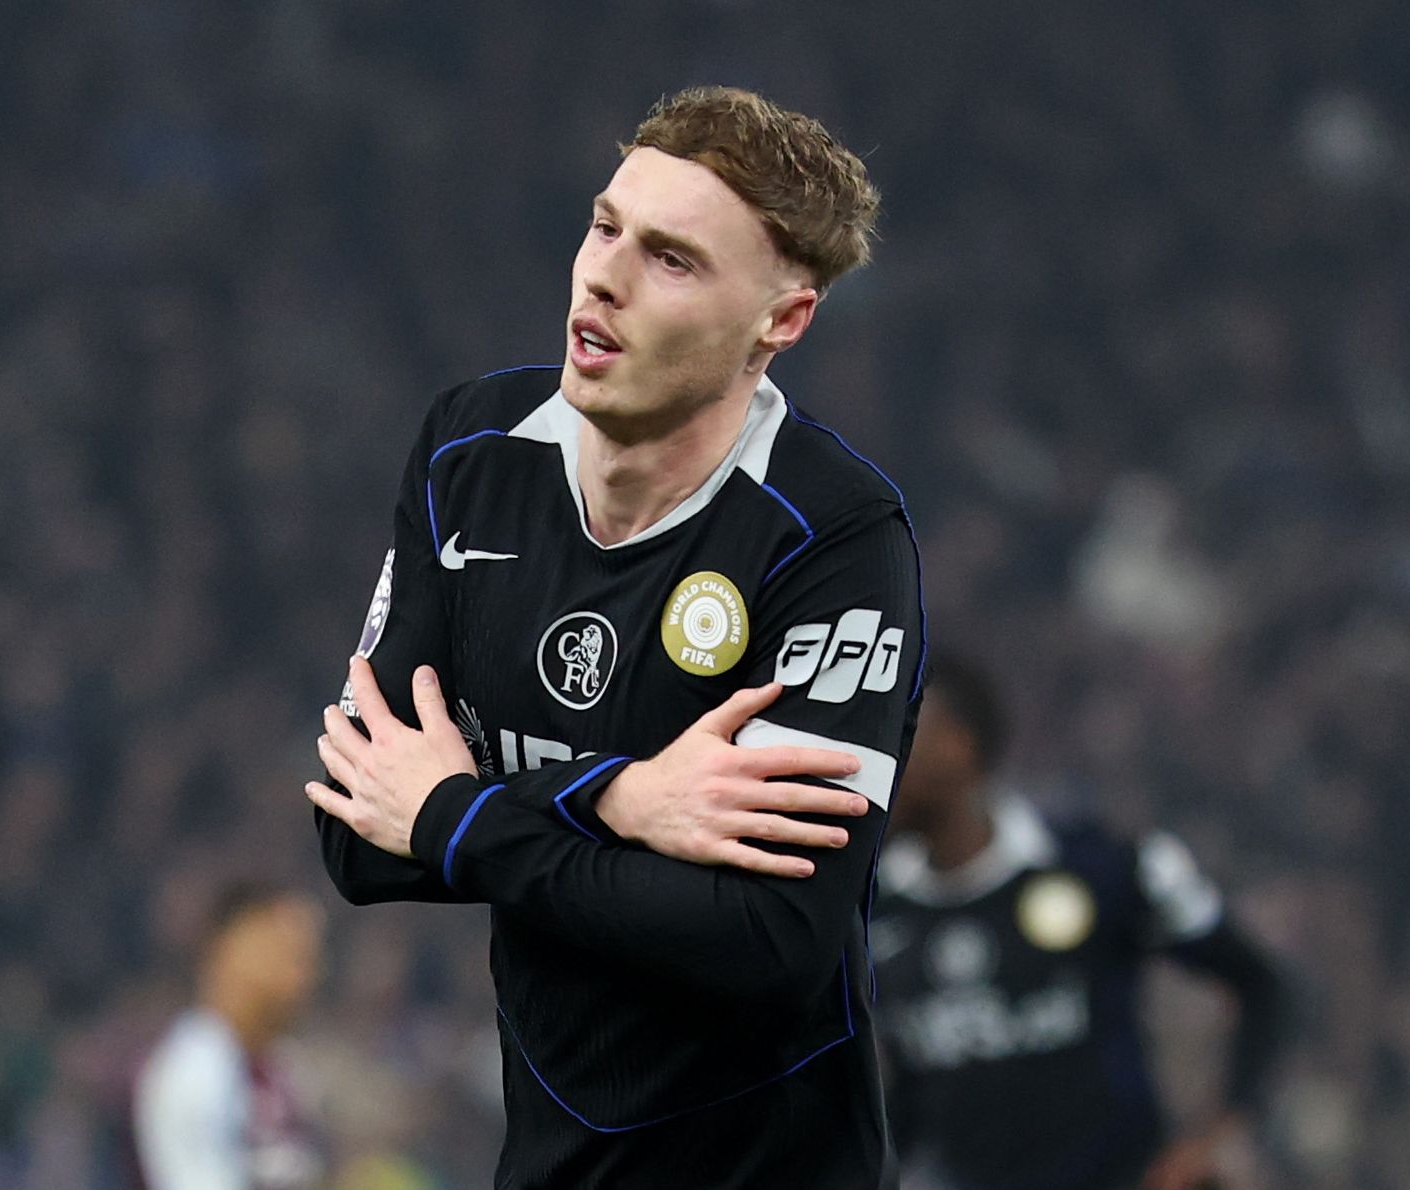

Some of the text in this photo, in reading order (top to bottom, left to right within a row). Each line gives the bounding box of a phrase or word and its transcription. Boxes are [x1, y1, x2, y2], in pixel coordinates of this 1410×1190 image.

[669, 581, 741, 645] WORLD CHAMPIONS
[681, 647, 716, 668] FIFA
